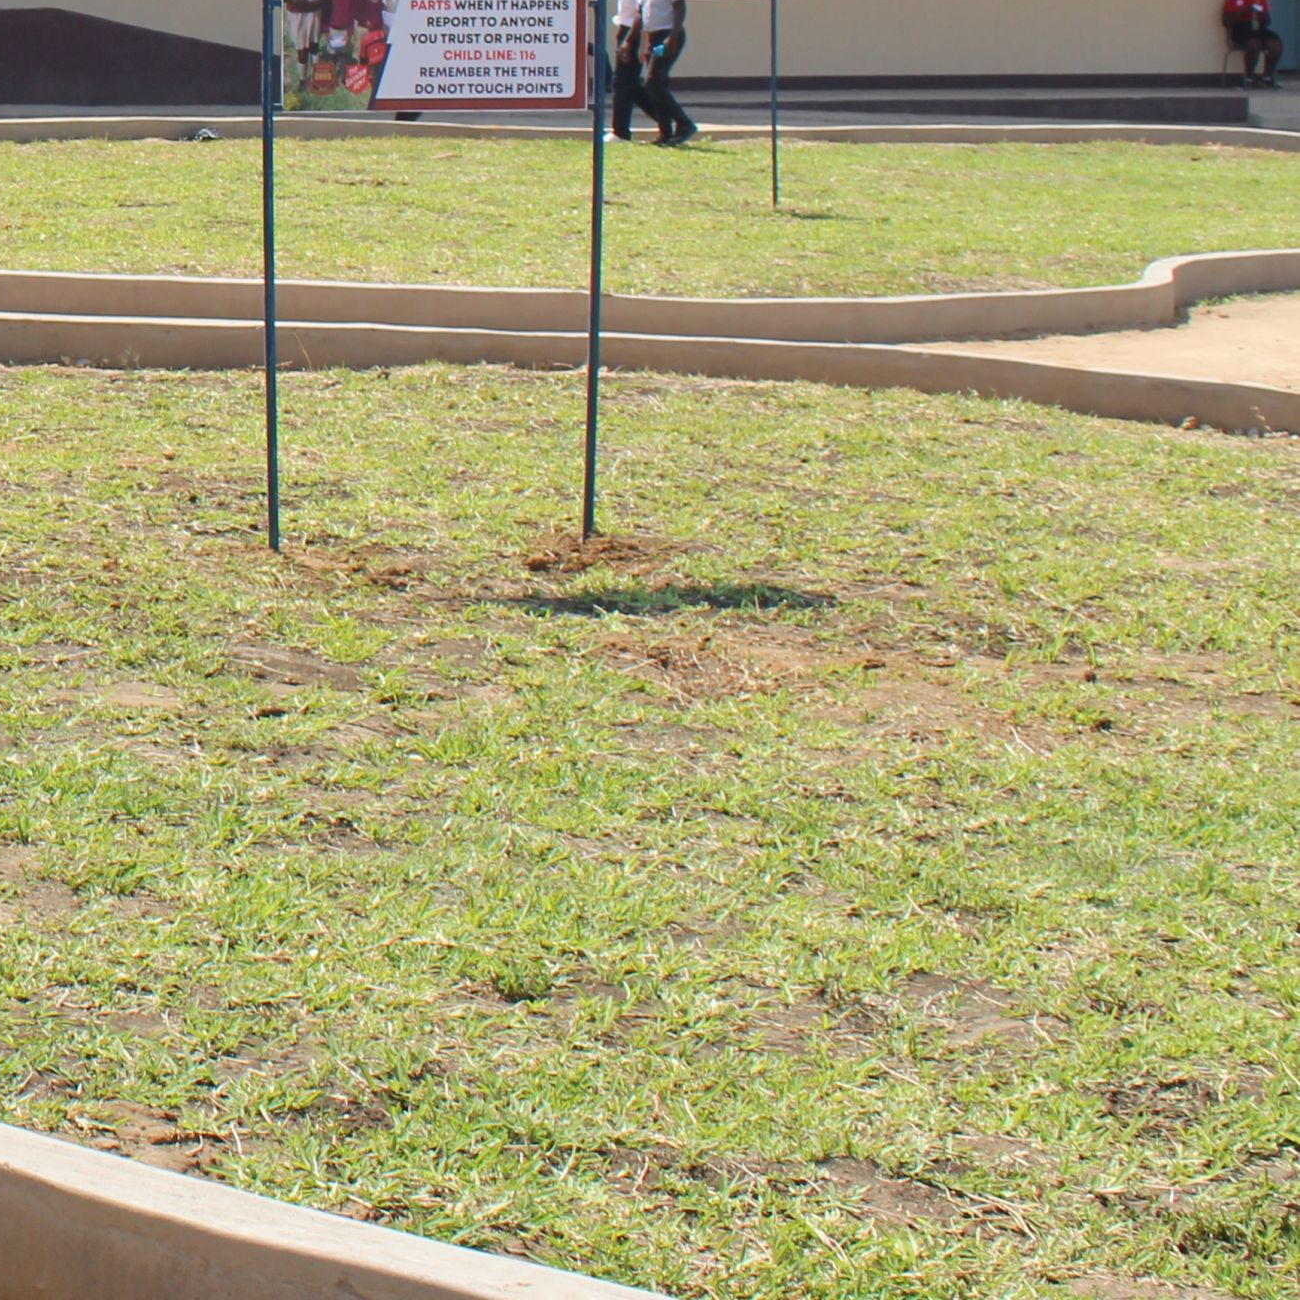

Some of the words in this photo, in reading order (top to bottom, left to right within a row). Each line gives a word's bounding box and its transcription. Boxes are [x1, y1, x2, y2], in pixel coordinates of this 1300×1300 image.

[411, 0, 451, 10] PARTS
[455, 0, 493, 10] WHEN
[497, 0, 507, 10] IT
[511, 0, 569, 10] HAPPENS
[427, 17, 477, 27] REPORT
[481, 17, 497, 27] TO
[501, 17, 554, 27] ANYONE
[411, 33, 438, 44] YOU
[441, 33, 482, 44] TRUST
[484, 33, 503, 44] OR
[506, 33, 550, 43] PHONE
[553, 33, 570, 43] TO
[444, 50, 482, 60] CHILD
[486, 50, 516, 60] LINE:
[520, 50, 536, 60] 116
[420, 67, 491, 77] REMEMBER
[495, 66, 518, 77] THE
[521, 66, 560, 77] THREE
[415, 84, 434, 94] DO
[438, 83, 465, 94] NOT
[468, 83, 514, 94] TOUCH
[517, 83, 564, 93] POINTS
